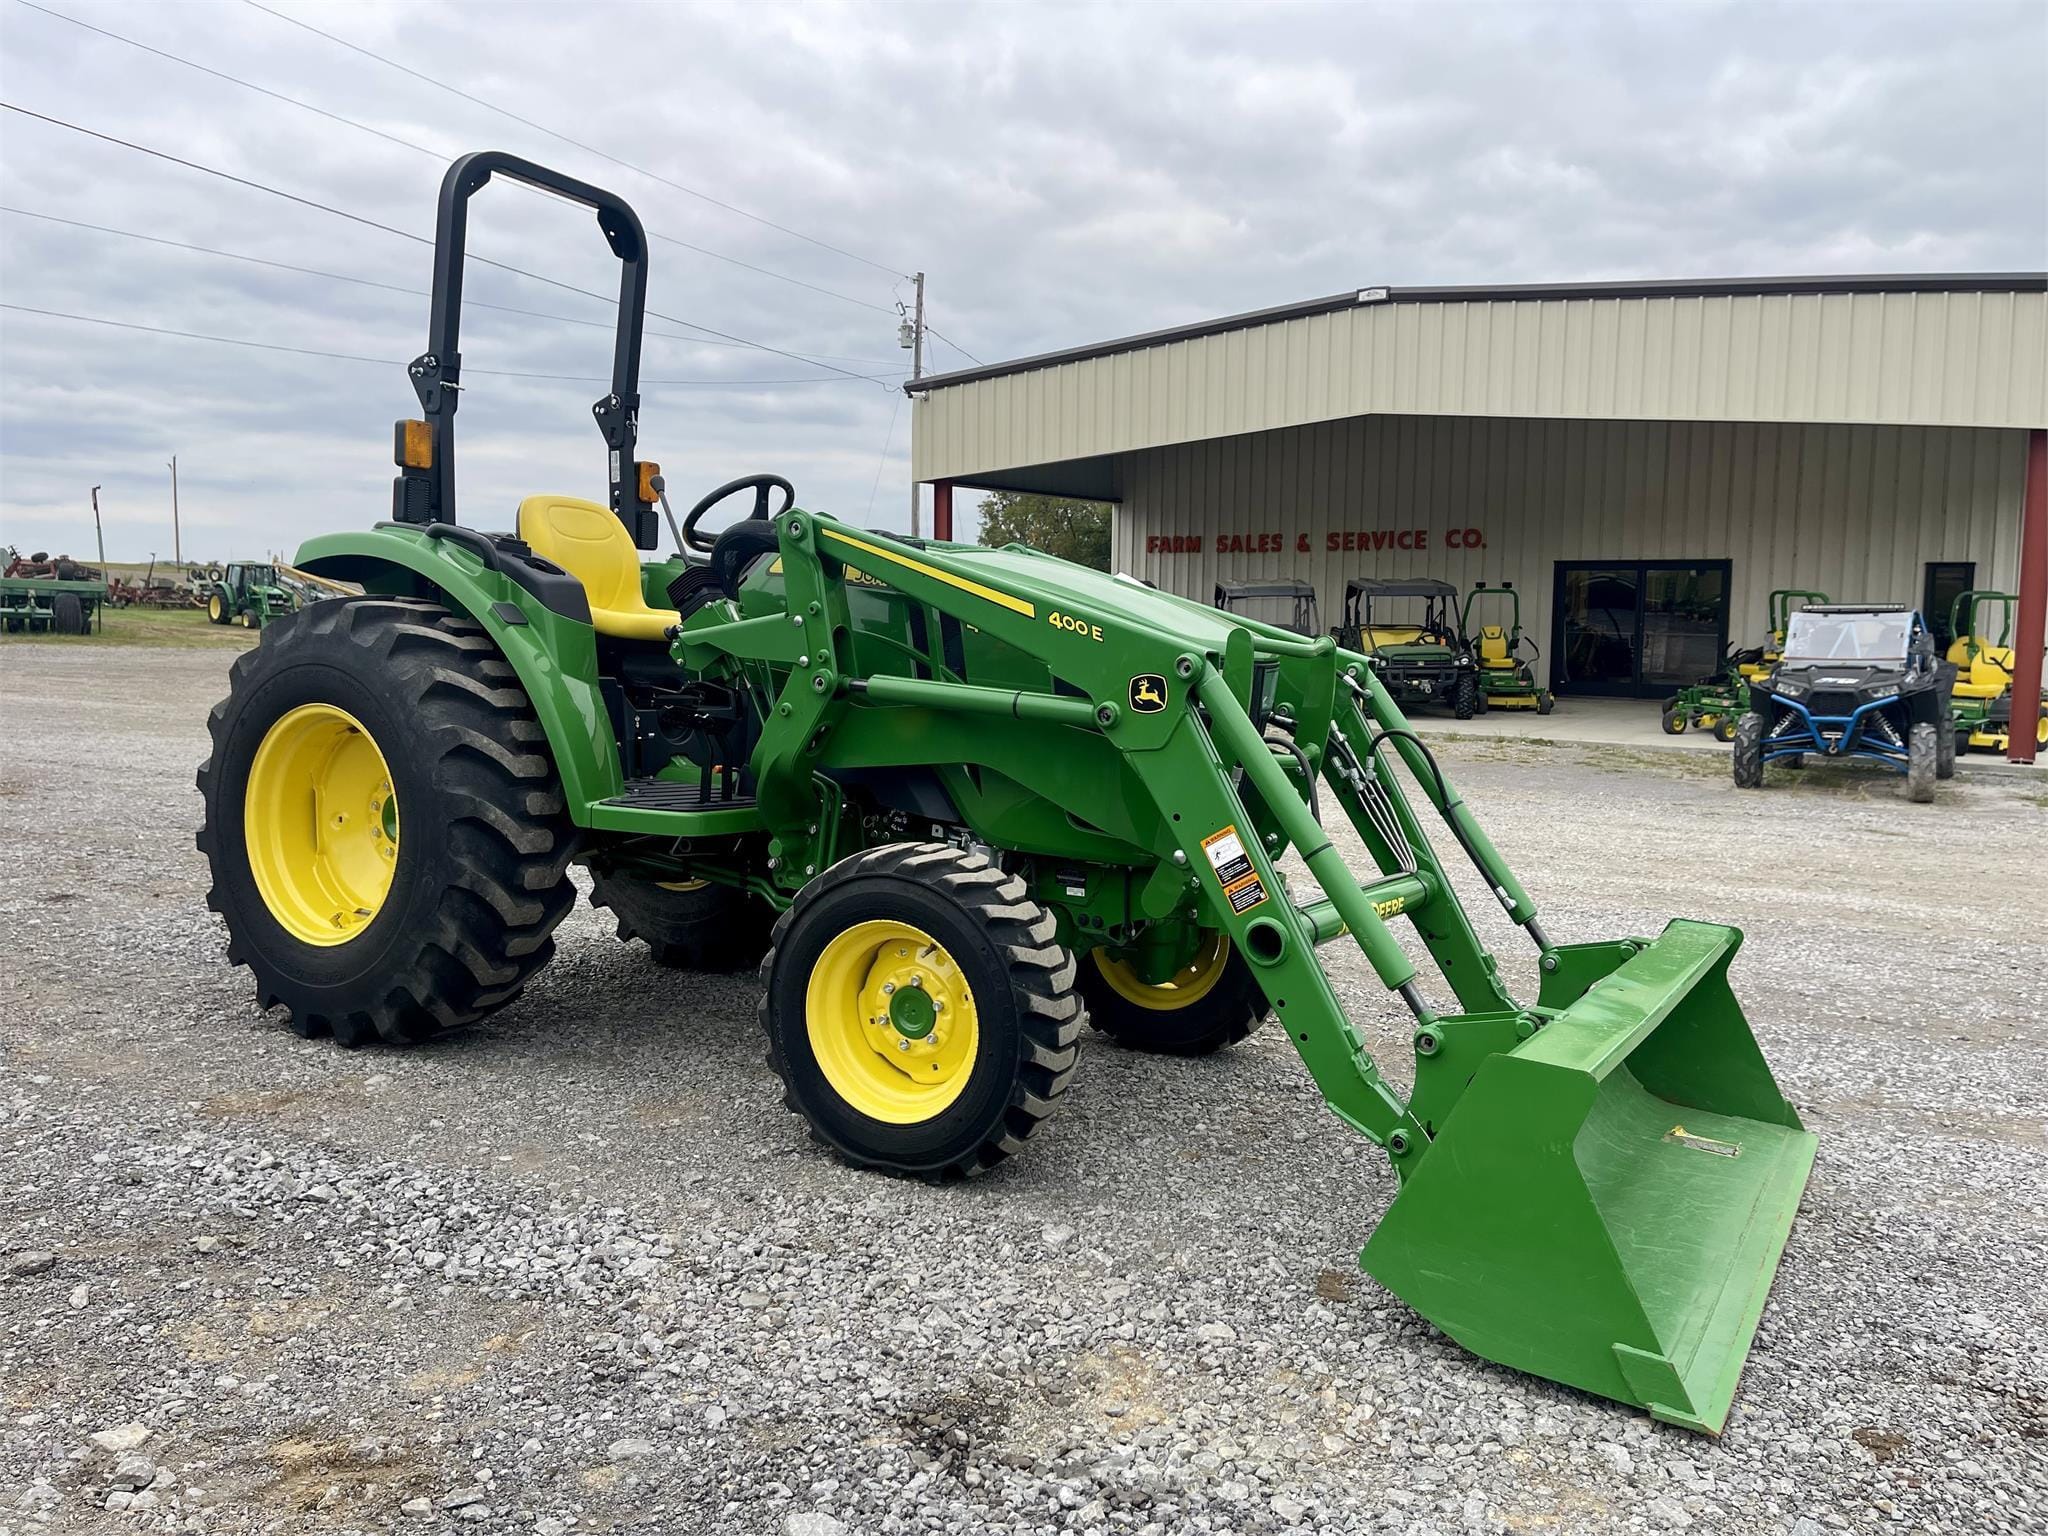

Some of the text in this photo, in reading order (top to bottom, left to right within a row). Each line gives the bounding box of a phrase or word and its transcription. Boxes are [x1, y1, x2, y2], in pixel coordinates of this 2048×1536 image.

[1146, 528, 1488, 553] FARM SALES & SERVICE CO.
[1048, 611, 1104, 642] 400 E
